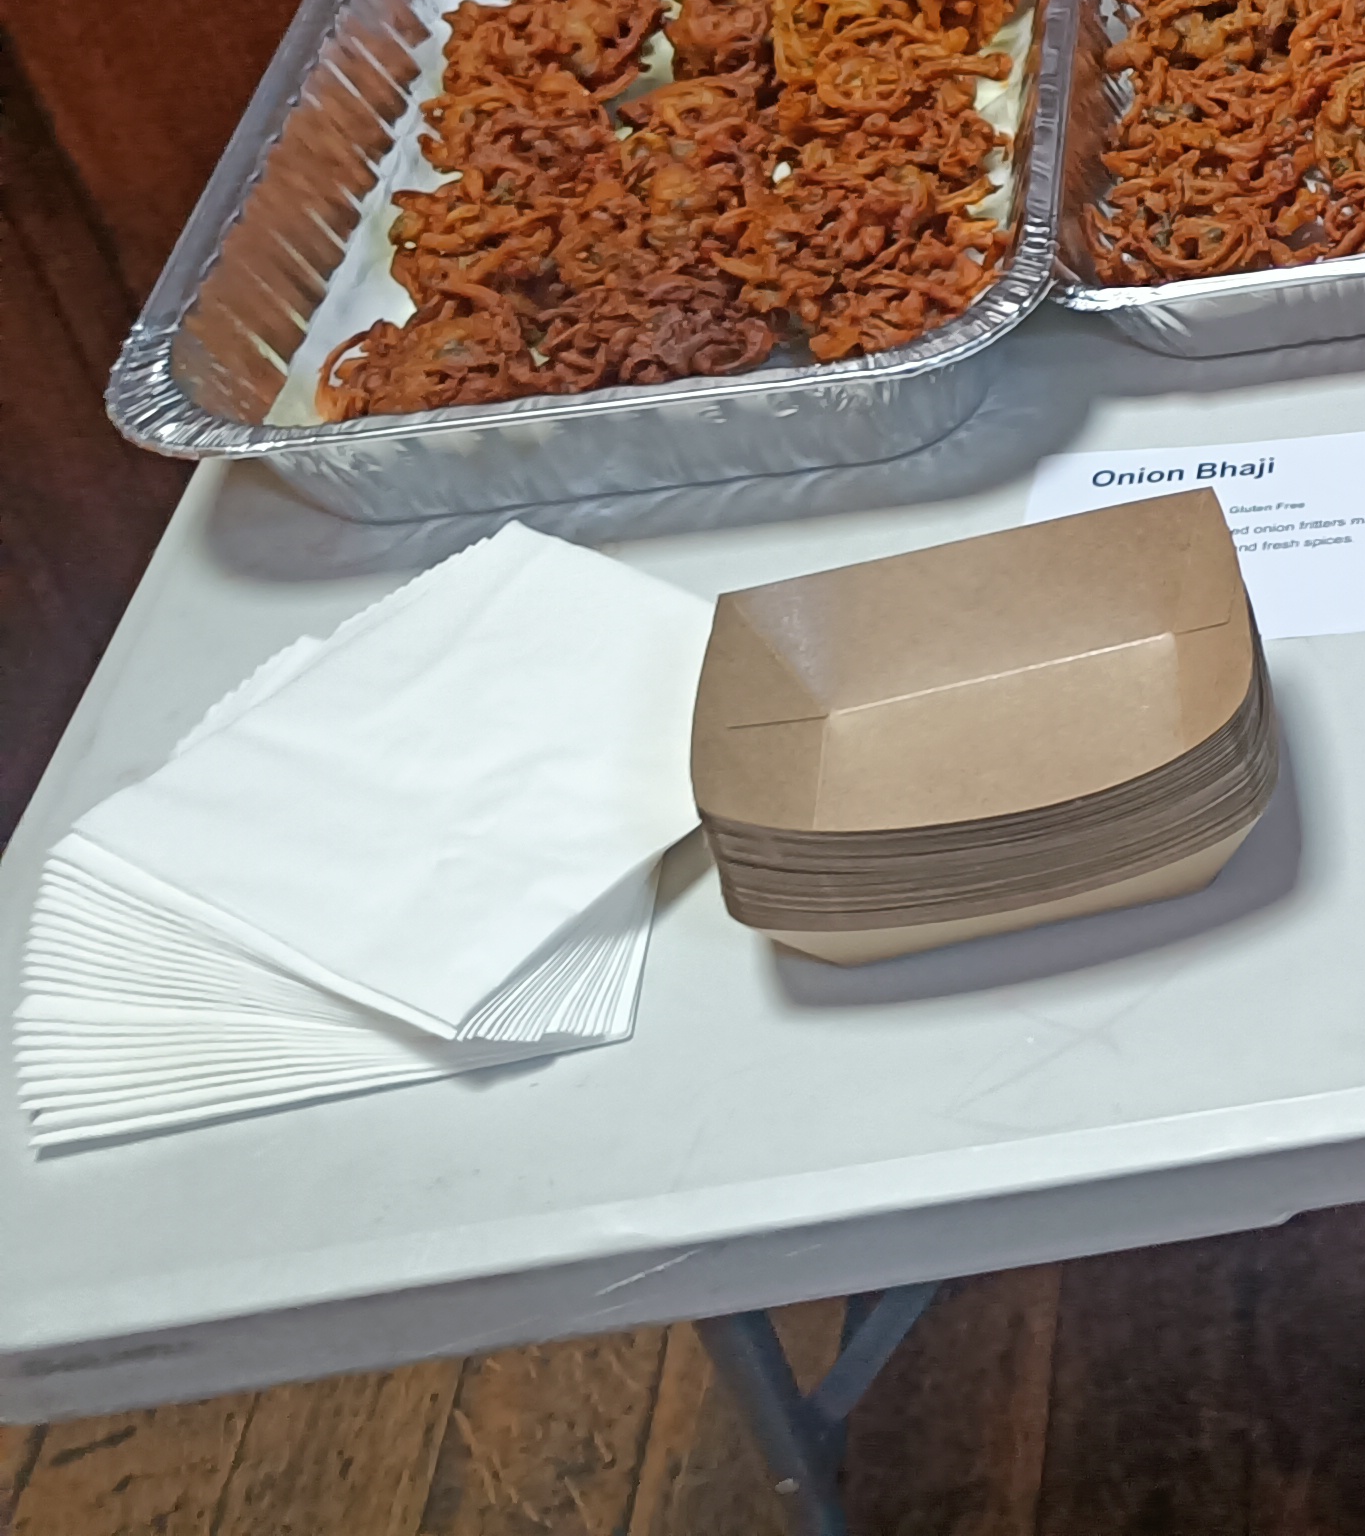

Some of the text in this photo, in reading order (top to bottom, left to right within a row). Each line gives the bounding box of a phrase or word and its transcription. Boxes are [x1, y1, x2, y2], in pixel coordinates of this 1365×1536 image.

[1092, 457, 1275, 487] Onion Bhaji
[1229, 502, 1305, 514] Gluten Free
[1254, 523, 1295, 534] onion
[1299, 519, 1346, 530] fritters
[1235, 542, 1257, 552] nd
[1262, 540, 1300, 551] fresh
